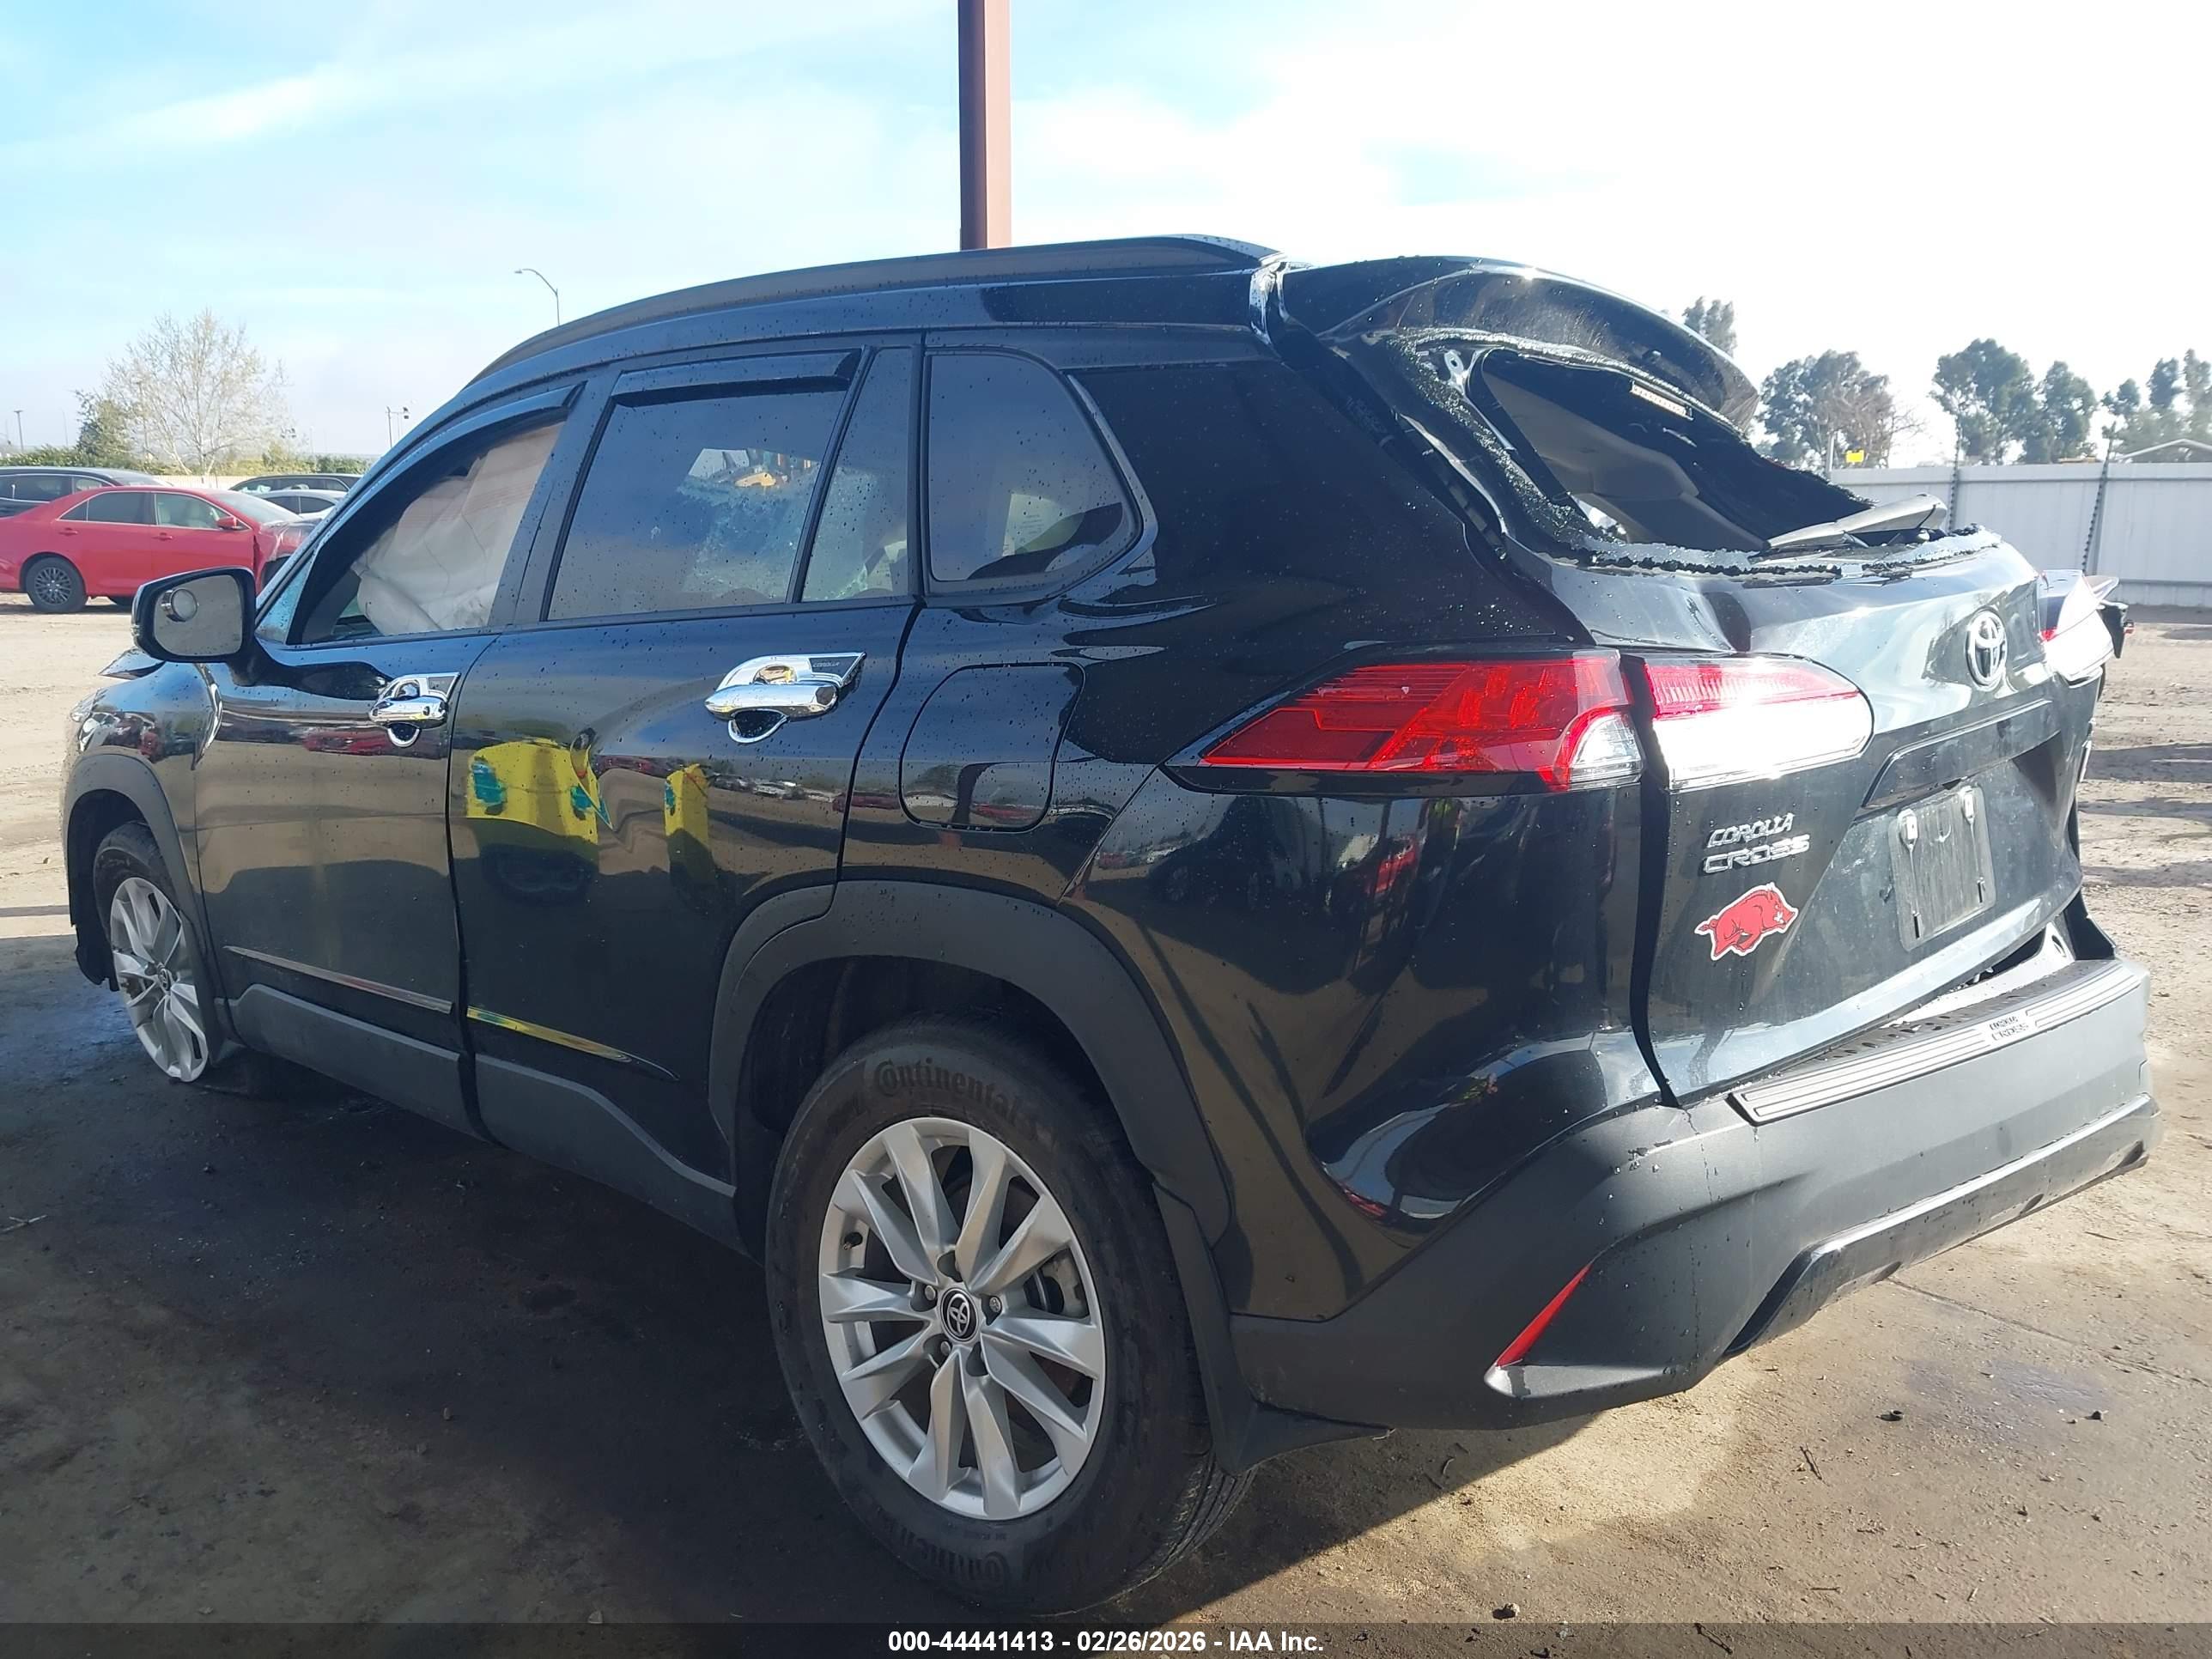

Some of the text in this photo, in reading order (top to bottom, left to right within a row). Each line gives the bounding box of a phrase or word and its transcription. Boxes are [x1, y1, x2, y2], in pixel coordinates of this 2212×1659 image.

[1707, 812, 1796, 848] COROLLA
[1704, 834, 1811, 874] CROSS
[873, 1056, 1023, 1126] Continental
